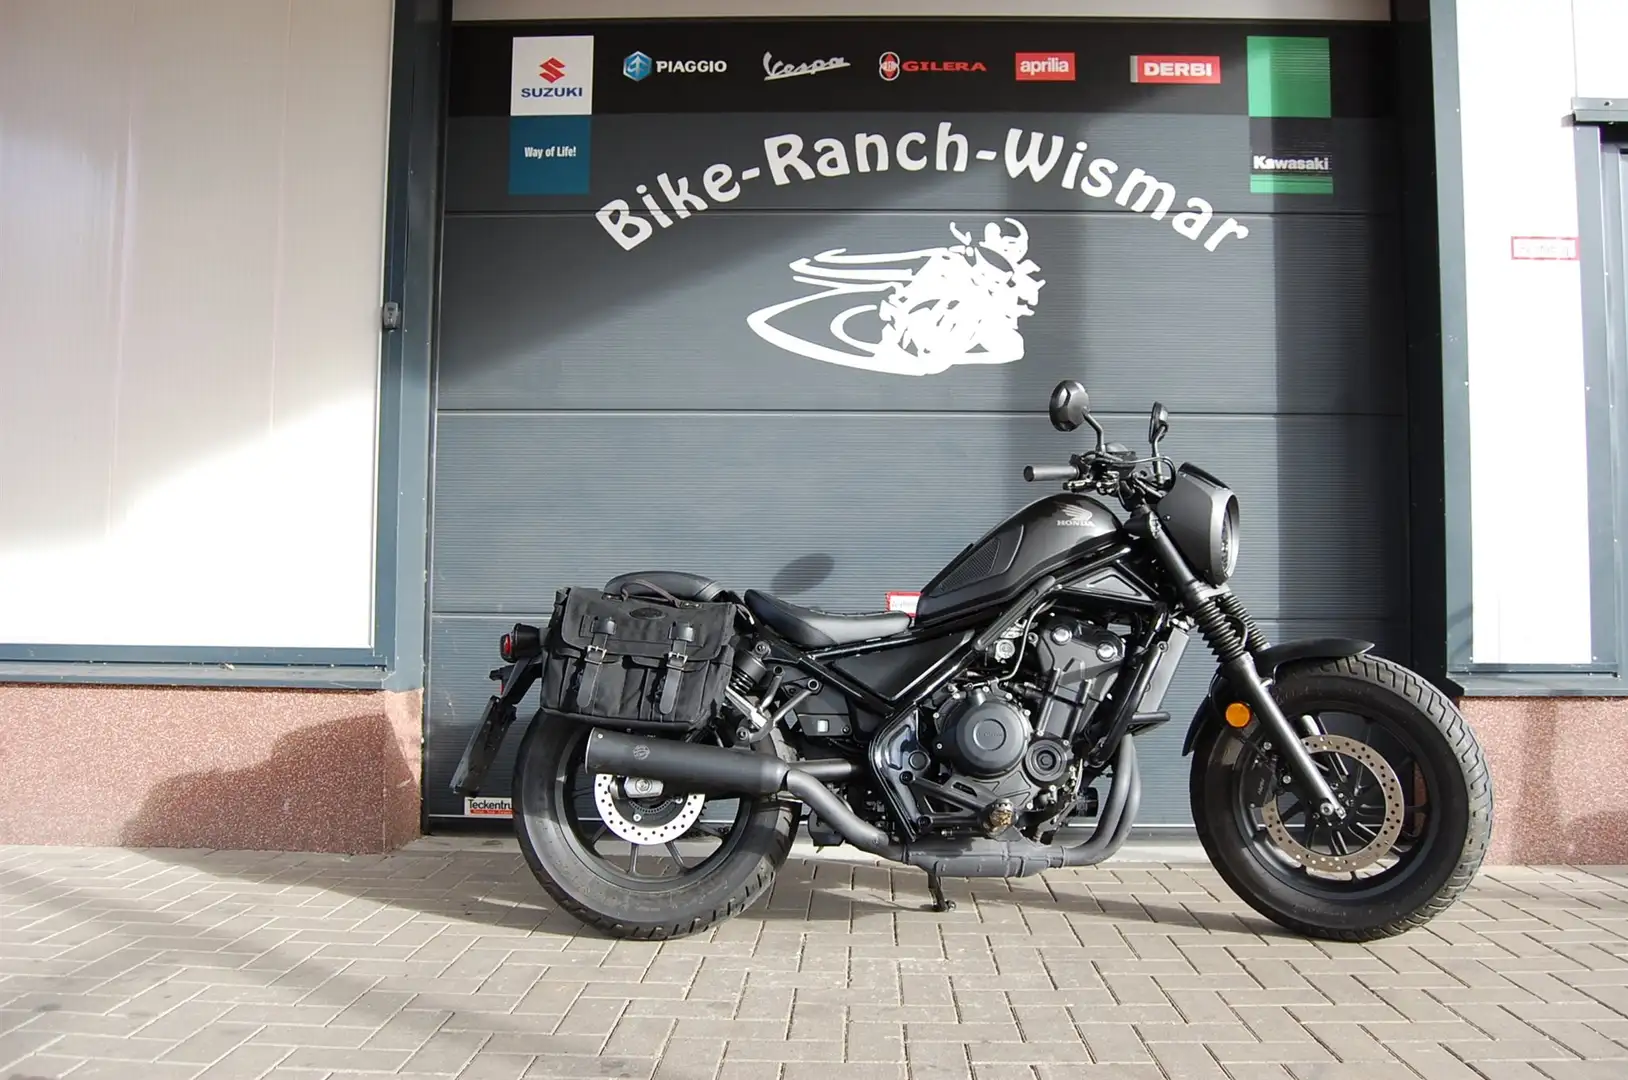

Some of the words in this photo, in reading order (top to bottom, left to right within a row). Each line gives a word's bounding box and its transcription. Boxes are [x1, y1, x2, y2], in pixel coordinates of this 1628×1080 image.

[656, 60, 727, 73] PIAGGIO
[763, 51, 850, 80] Vespa
[902, 60, 988, 73] GILERA
[1019, 56, 1070, 76] aprilia
[1143, 61, 1213, 77] DERBI
[521, 87, 583, 98] SUZUKI
[524, 147, 543, 160] Way
[545, 146, 555, 158] of
[556, 146, 577, 158] Life!
[1253, 155, 1329, 170] Kawasaki
[596, 121, 1249, 252] Bike-Ranch-Wismar
